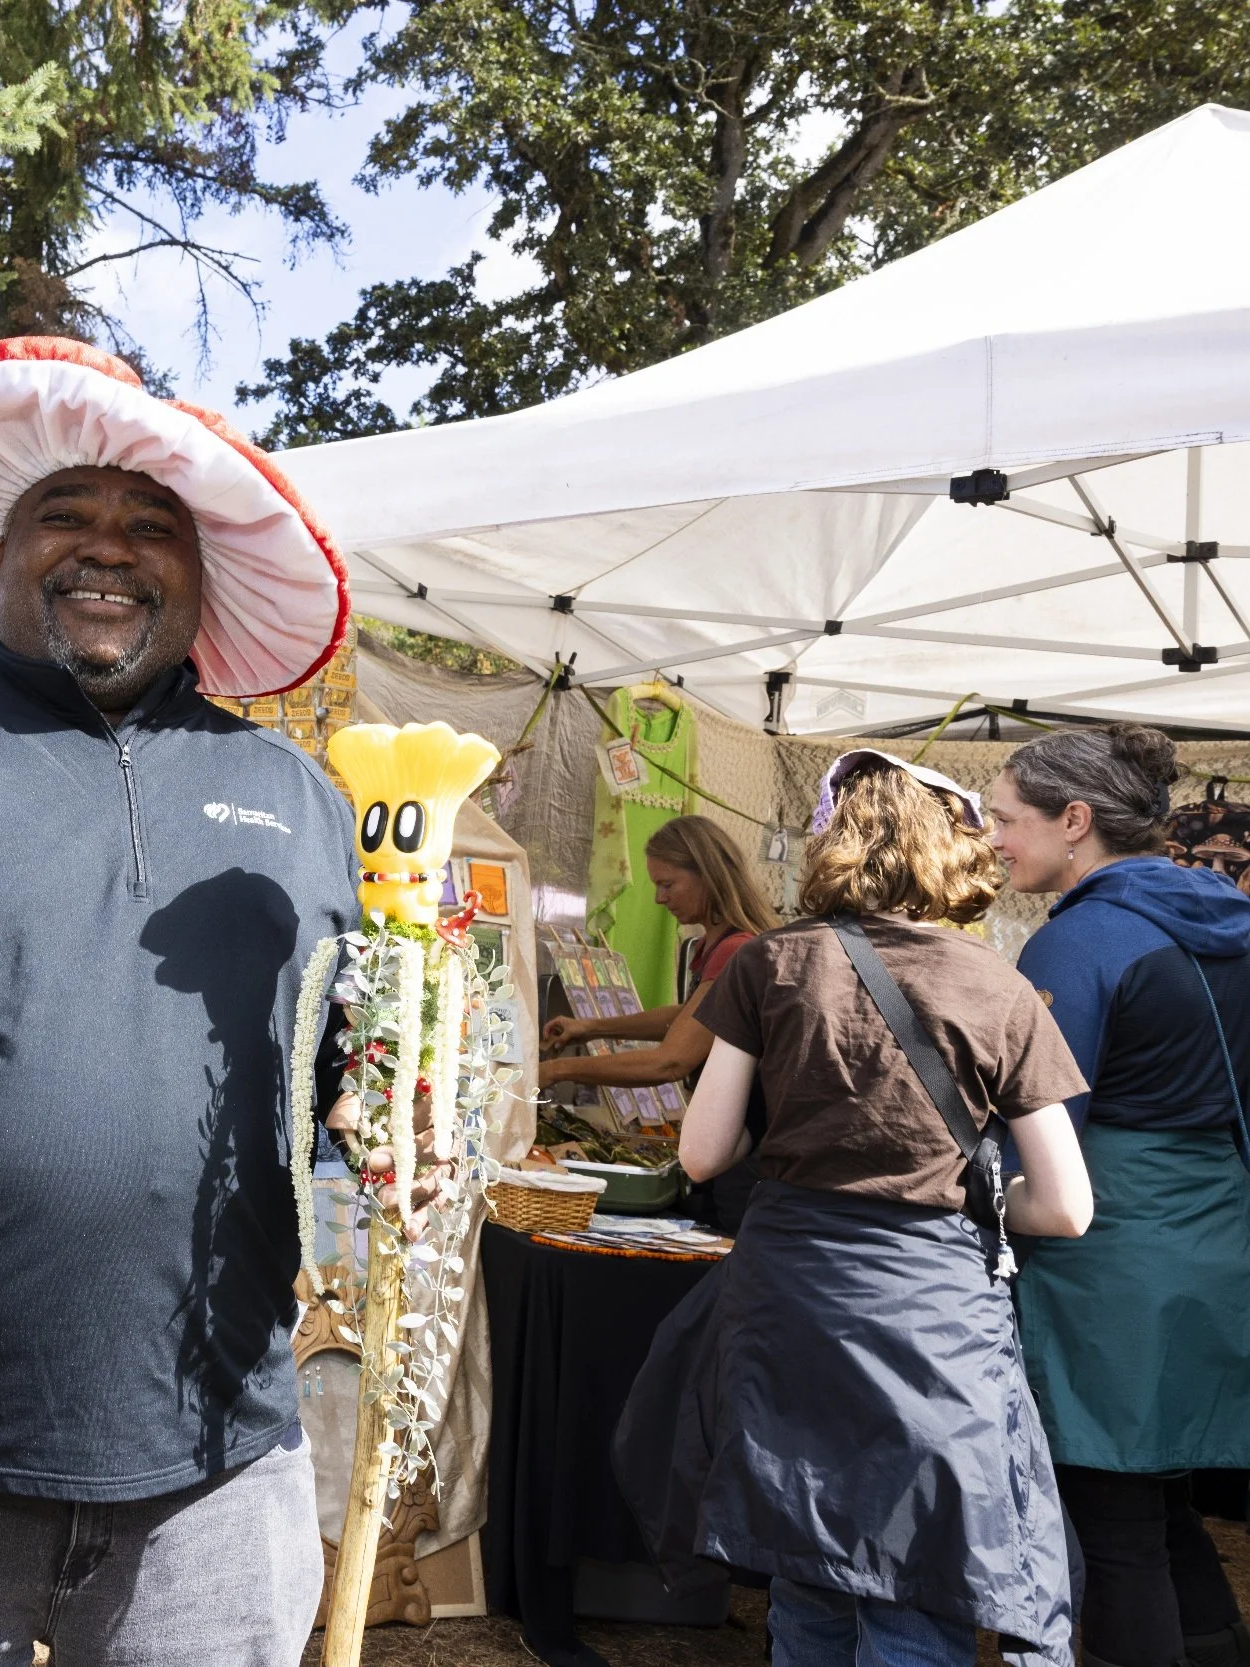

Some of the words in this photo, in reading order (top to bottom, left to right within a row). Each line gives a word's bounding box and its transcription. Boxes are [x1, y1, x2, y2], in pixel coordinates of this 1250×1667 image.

[253, 705, 274, 713] ZEEDS
[291, 709, 312, 717] ZEEDS
[237, 807, 276, 820] Samaritan
[239, 815, 264, 825] Health
[264, 819, 291, 833] Services
